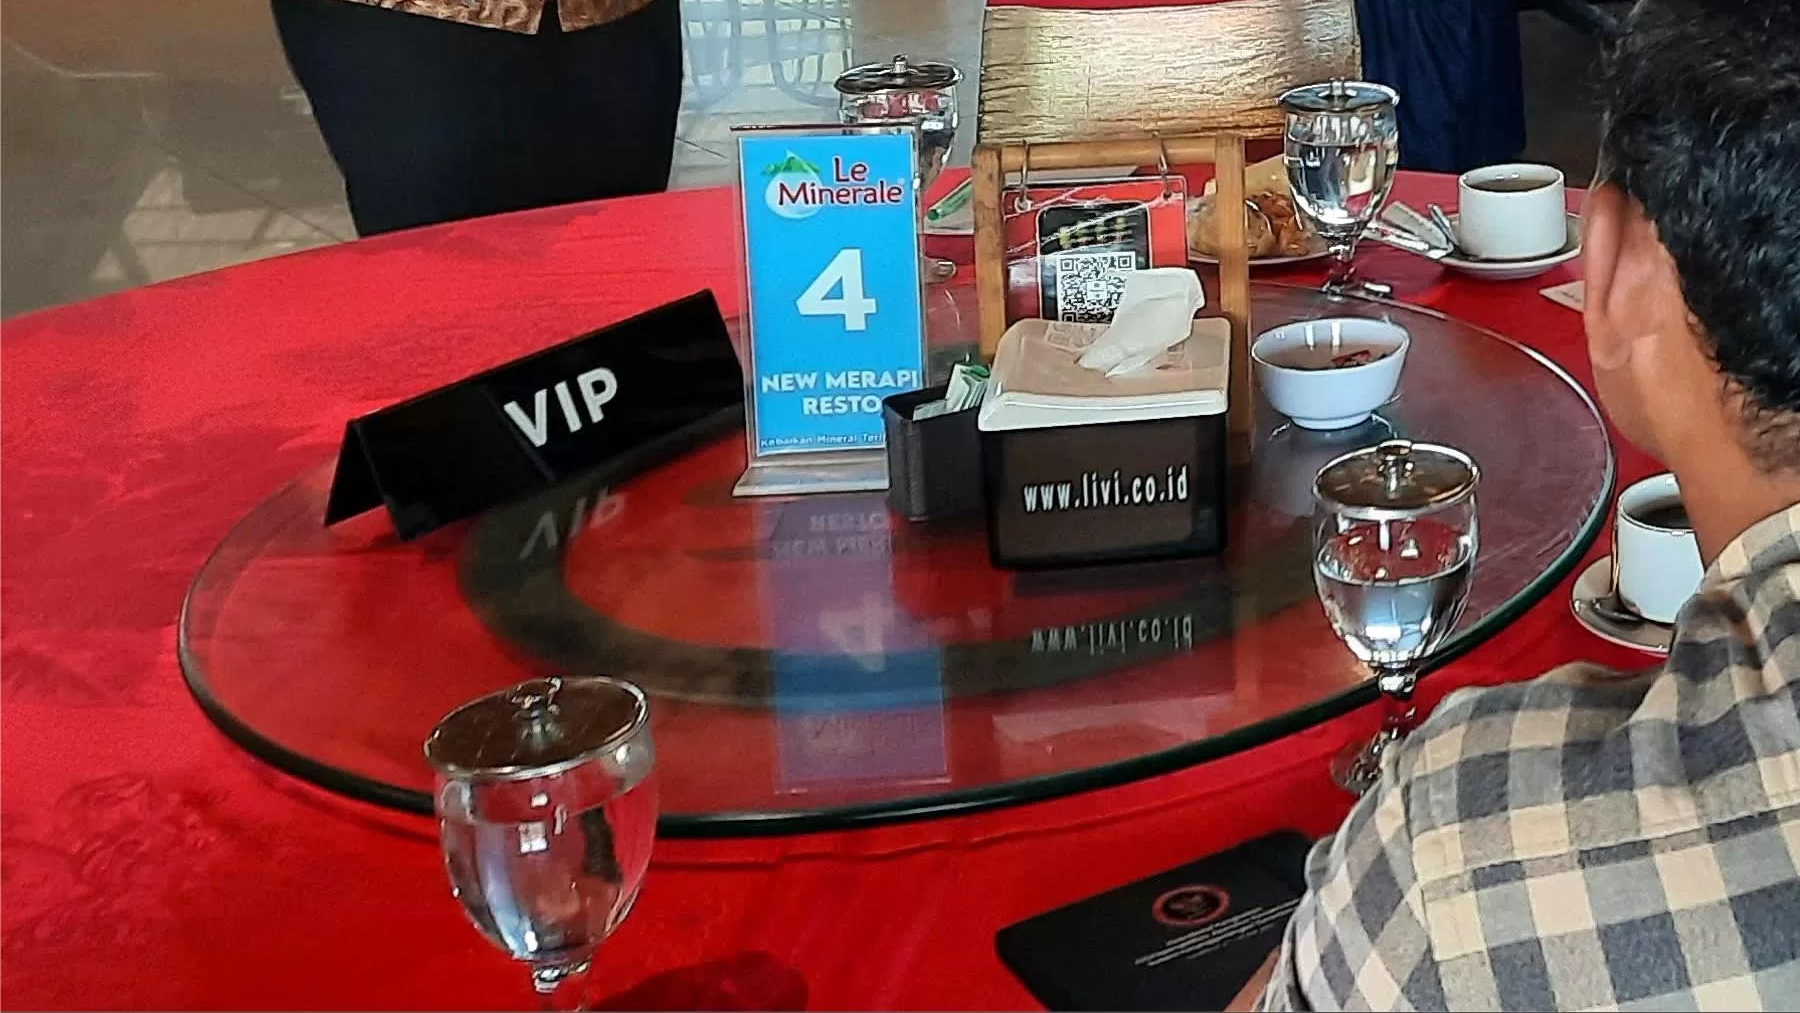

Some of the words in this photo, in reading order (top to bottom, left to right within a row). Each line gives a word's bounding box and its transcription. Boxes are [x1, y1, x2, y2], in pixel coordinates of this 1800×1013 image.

[833, 156, 869, 184] Le
[777, 179, 903, 207] Minerale
[796, 248, 877, 331] 4
[761, 372, 817, 393] NEW
[825, 370, 918, 389] MERAPI
[503, 367, 618, 447] VIP
[803, 395, 882, 415] RESTO
[817, 434, 857, 444] Mineral
[1023, 465, 1188, 512] www.livi.co.id
